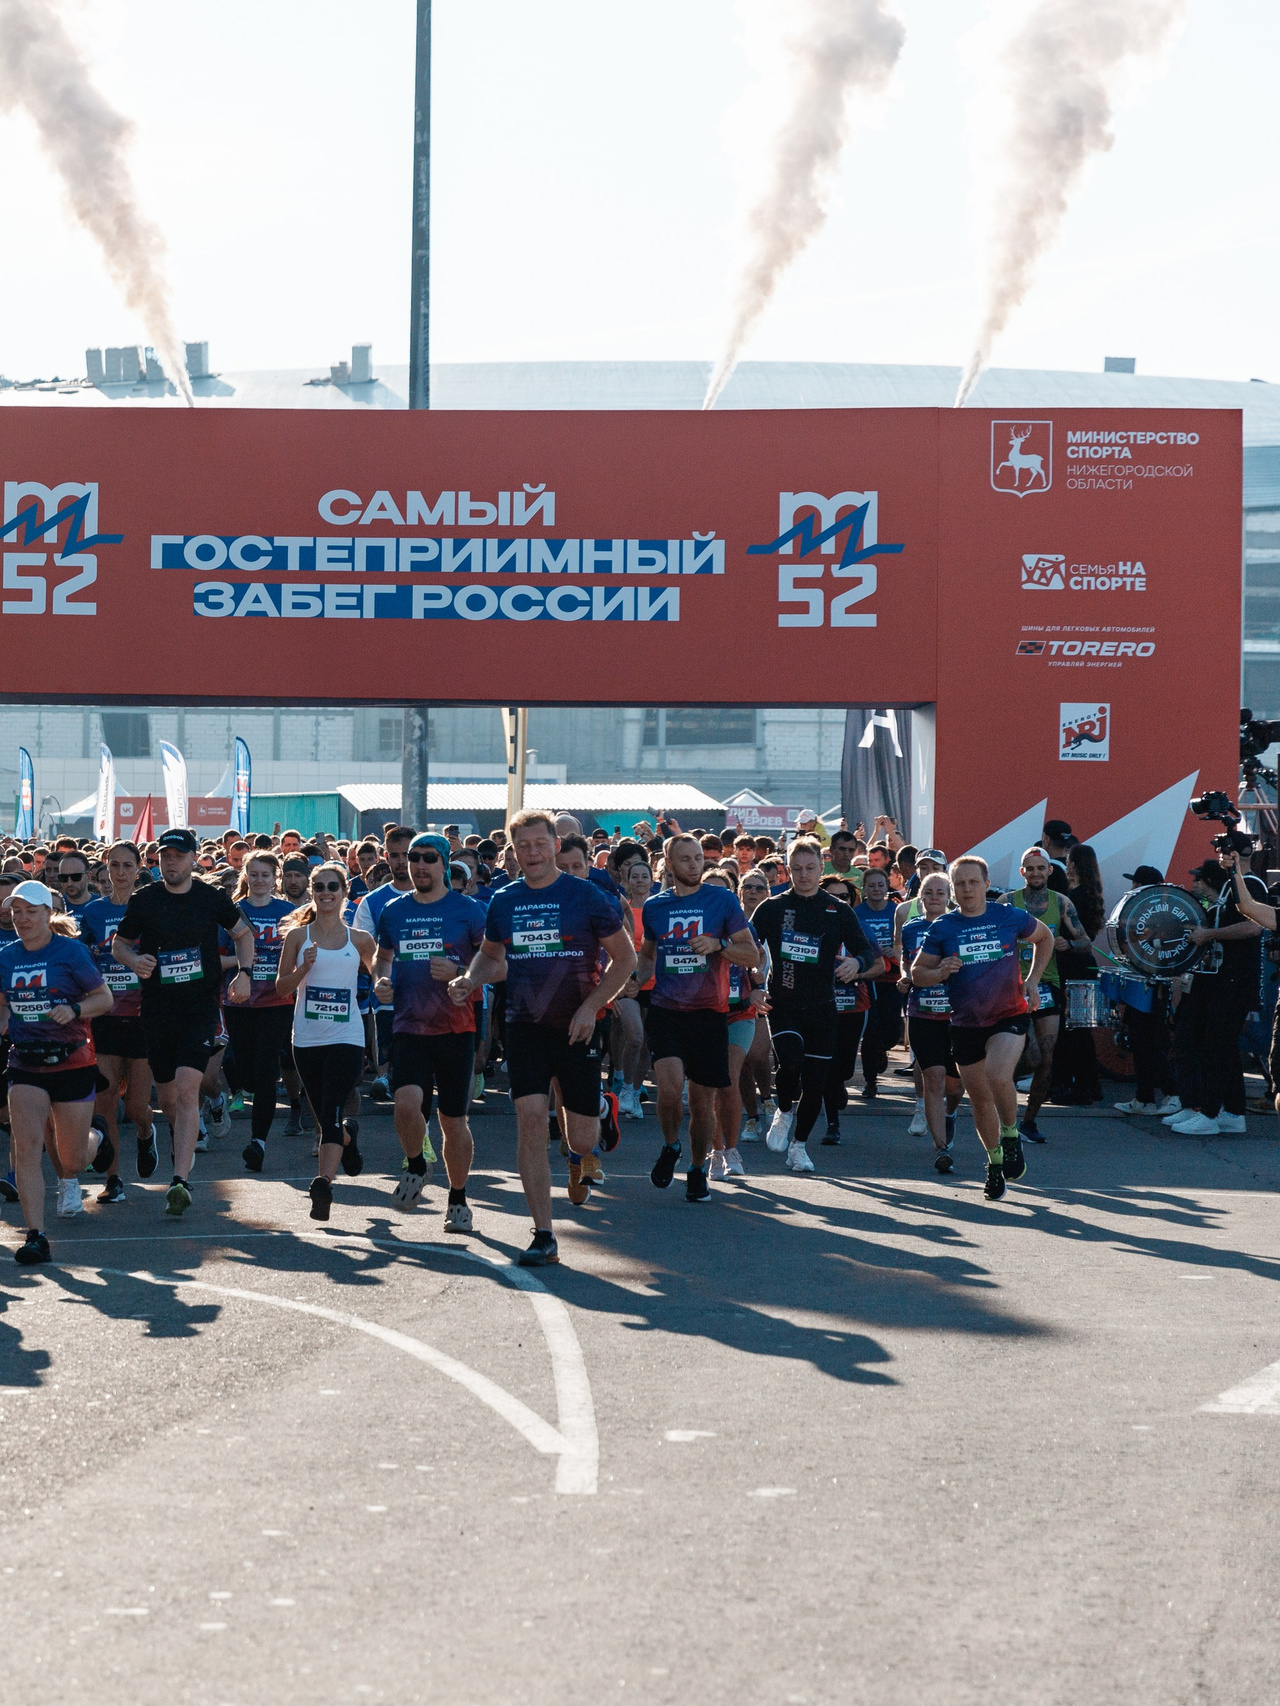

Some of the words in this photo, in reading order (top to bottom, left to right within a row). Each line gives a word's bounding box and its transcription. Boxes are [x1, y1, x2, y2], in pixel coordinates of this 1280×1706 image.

[1067, 430, 1200, 446] МИНИСТЕРСТВО
[1066, 446, 1133, 459] СПОРТА
[1066, 463, 1194, 478] НИЖЕГОРОДСКОЙ
[1066, 478, 1133, 490] ОБЛАСТИ
[317, 482, 556, 527] САМЫЙ
[150, 530, 726, 575] ГОСТЕПРИИМНЫЙ
[1069, 563, 1116, 575] СЕМЬЯ
[1118, 561, 1147, 576] НА
[1, 552, 98, 616] 52
[1069, 576, 1147, 592] СПОРТЕ
[193, 582, 396, 618] ЗАБЕГ
[411, 584, 681, 622] РОССИИ
[777, 563, 878, 628] 52
[1048, 640, 1156, 657] TORERO
[729, 808, 759, 817] ЛИГА
[739, 816, 783, 826] ГЕРОЕВ
[1135, 902, 1169, 935] ГОРЬКИЙ
[1171, 906, 1189, 922] БИТ
[521, 933, 552, 942] 7943
[406, 942, 435, 950] 6657
[789, 946, 811, 954] 7319
[966, 944, 993, 953] 6276
[168, 965, 193, 974] 7757
[315, 1003, 339, 1012] 7214
